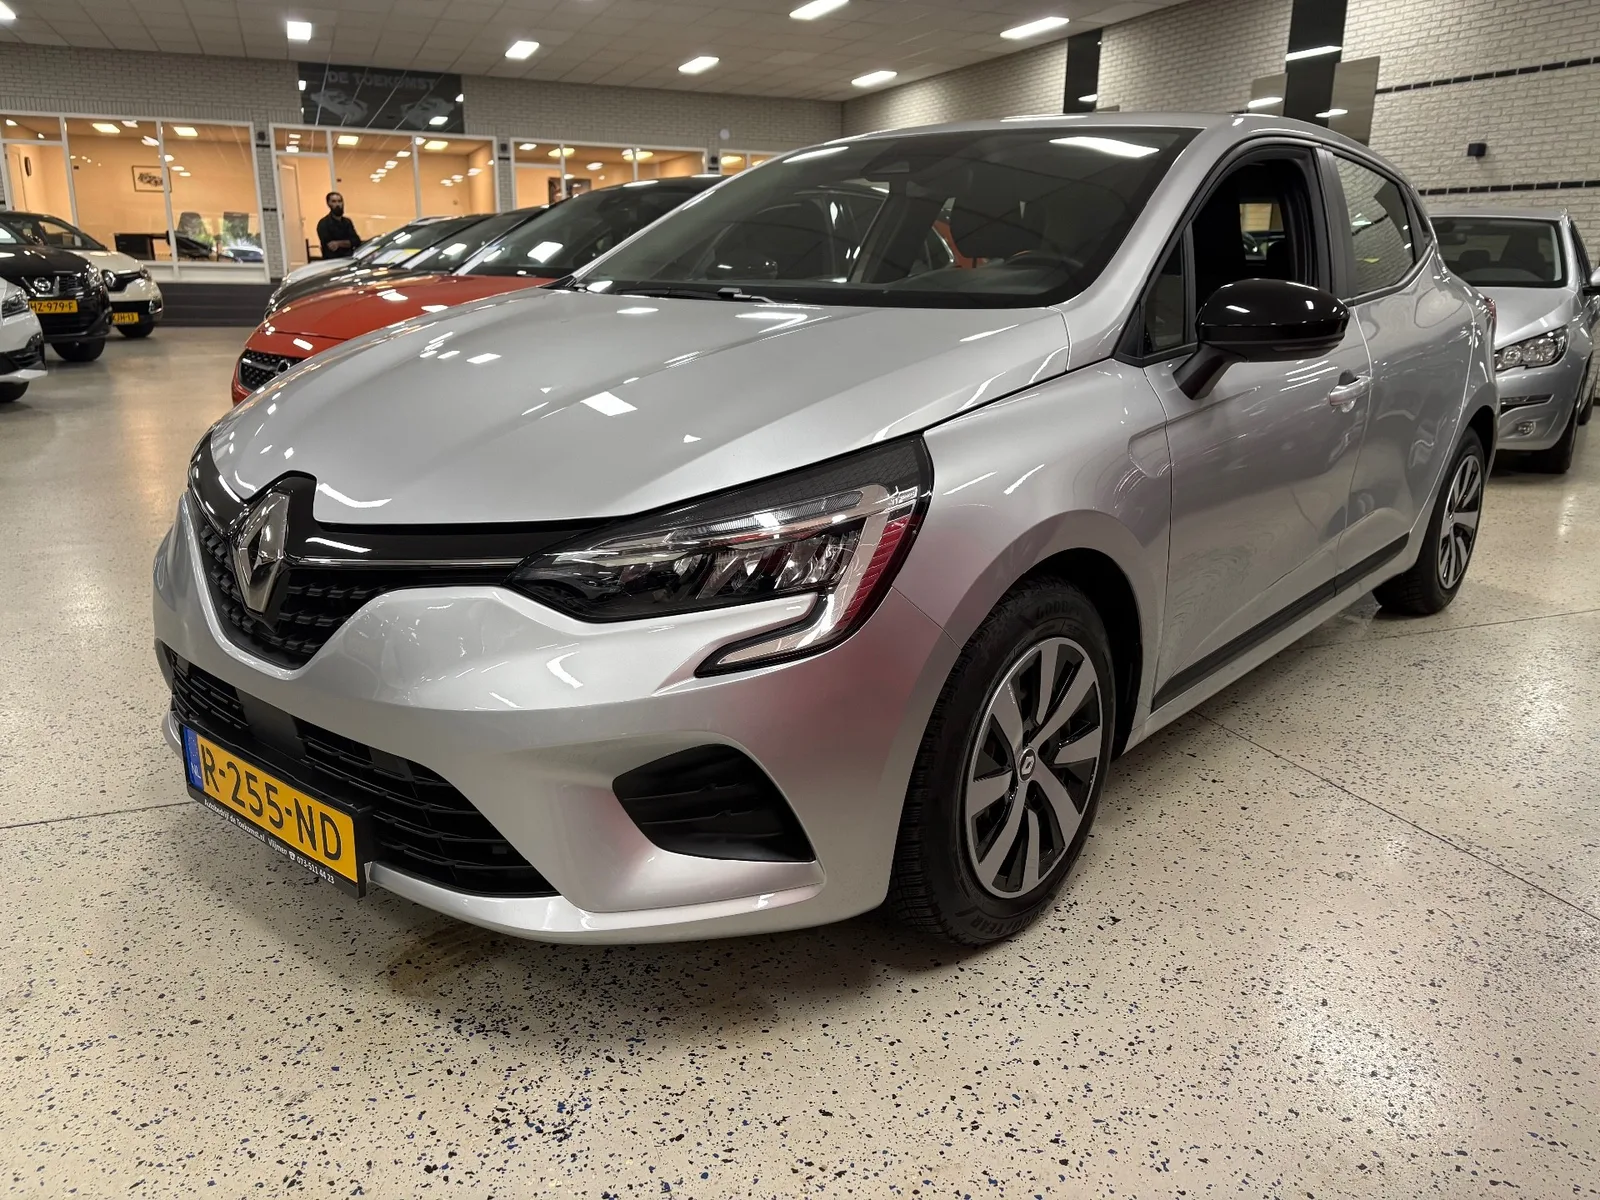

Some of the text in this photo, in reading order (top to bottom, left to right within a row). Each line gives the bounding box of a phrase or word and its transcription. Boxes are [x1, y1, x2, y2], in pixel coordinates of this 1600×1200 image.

[328, 70, 436, 91] DE TOEKOMST
[31, 302, 74, 312] HZ-979-F
[190, 762, 202, 780] NL
[201, 744, 342, 861] R-255-ND
